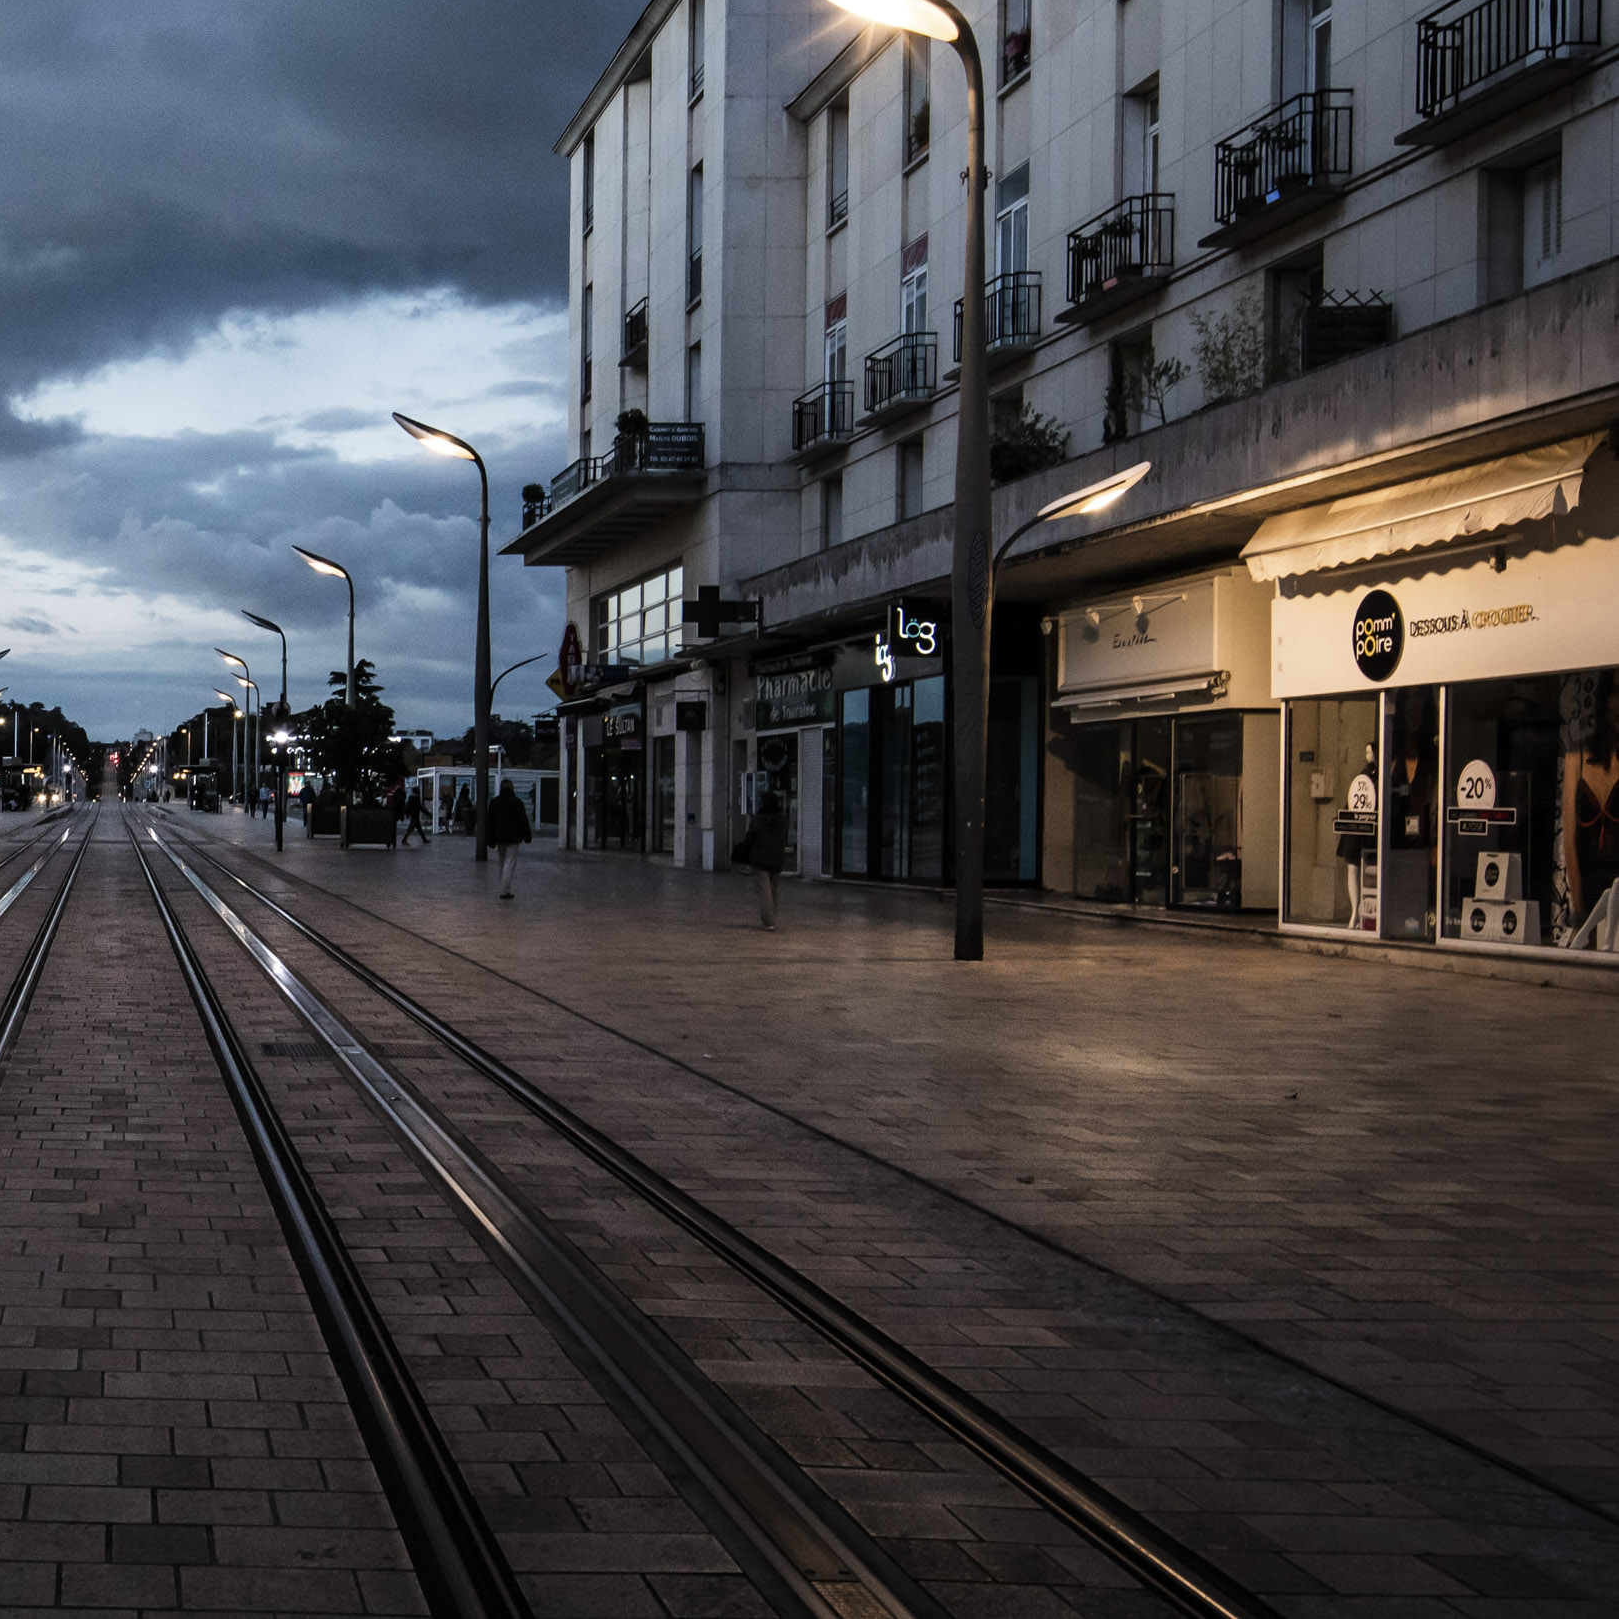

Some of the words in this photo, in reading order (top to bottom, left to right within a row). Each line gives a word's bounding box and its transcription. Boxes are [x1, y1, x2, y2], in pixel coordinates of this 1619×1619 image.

[671, 434, 699, 442] DUBOIS
[1410, 615, 1461, 637] DESSOUS
[756, 668, 833, 701] Pharmacie
[781, 702, 818, 721] Touraine
[1460, 777, 1492, 800] -20%
